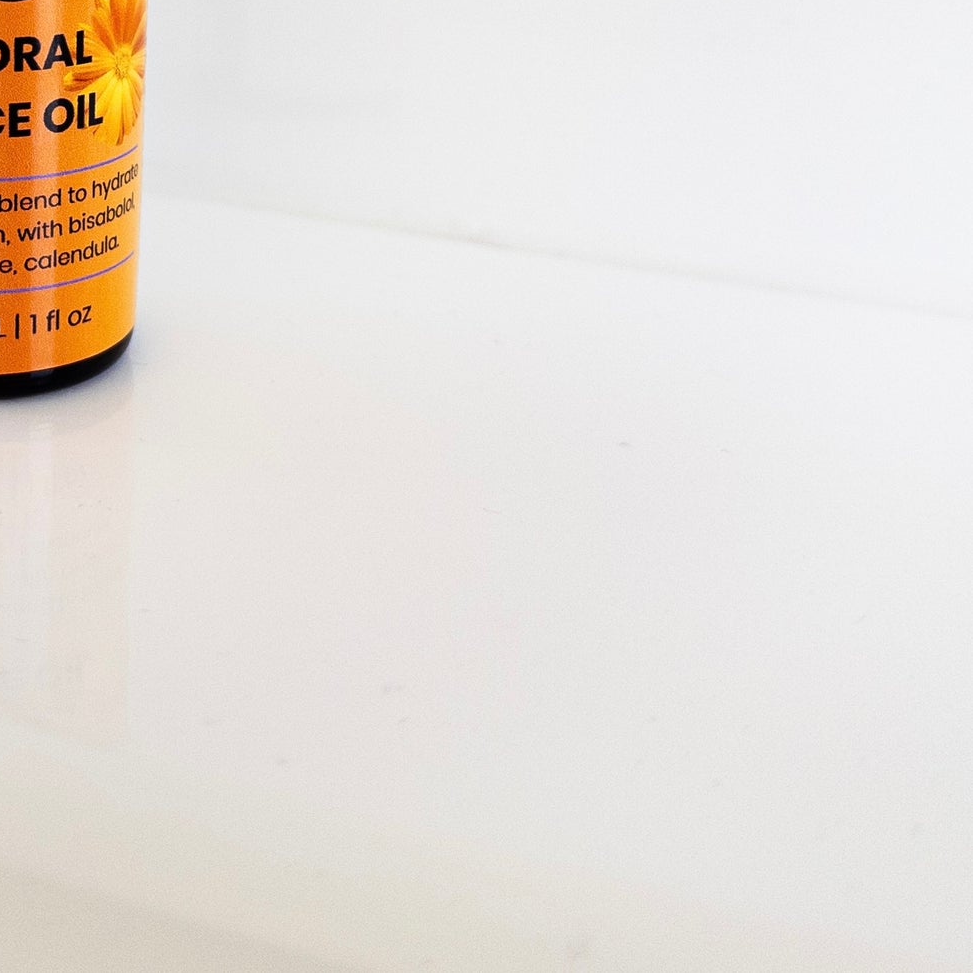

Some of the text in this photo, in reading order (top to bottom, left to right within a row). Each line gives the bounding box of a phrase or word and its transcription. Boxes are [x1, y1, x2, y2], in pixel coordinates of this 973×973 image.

[43, 92, 104, 133] OIL
[68, 184, 87, 203] to
[92, 162, 139, 200] hydrate
[17, 220, 63, 243] with
[69, 194, 136, 234] bisabolol,
[24, 233, 120, 272] calendula.
[29, 314, 38, 335] 1
[46, 308, 61, 333] fl
[67, 305, 92, 327] oz
